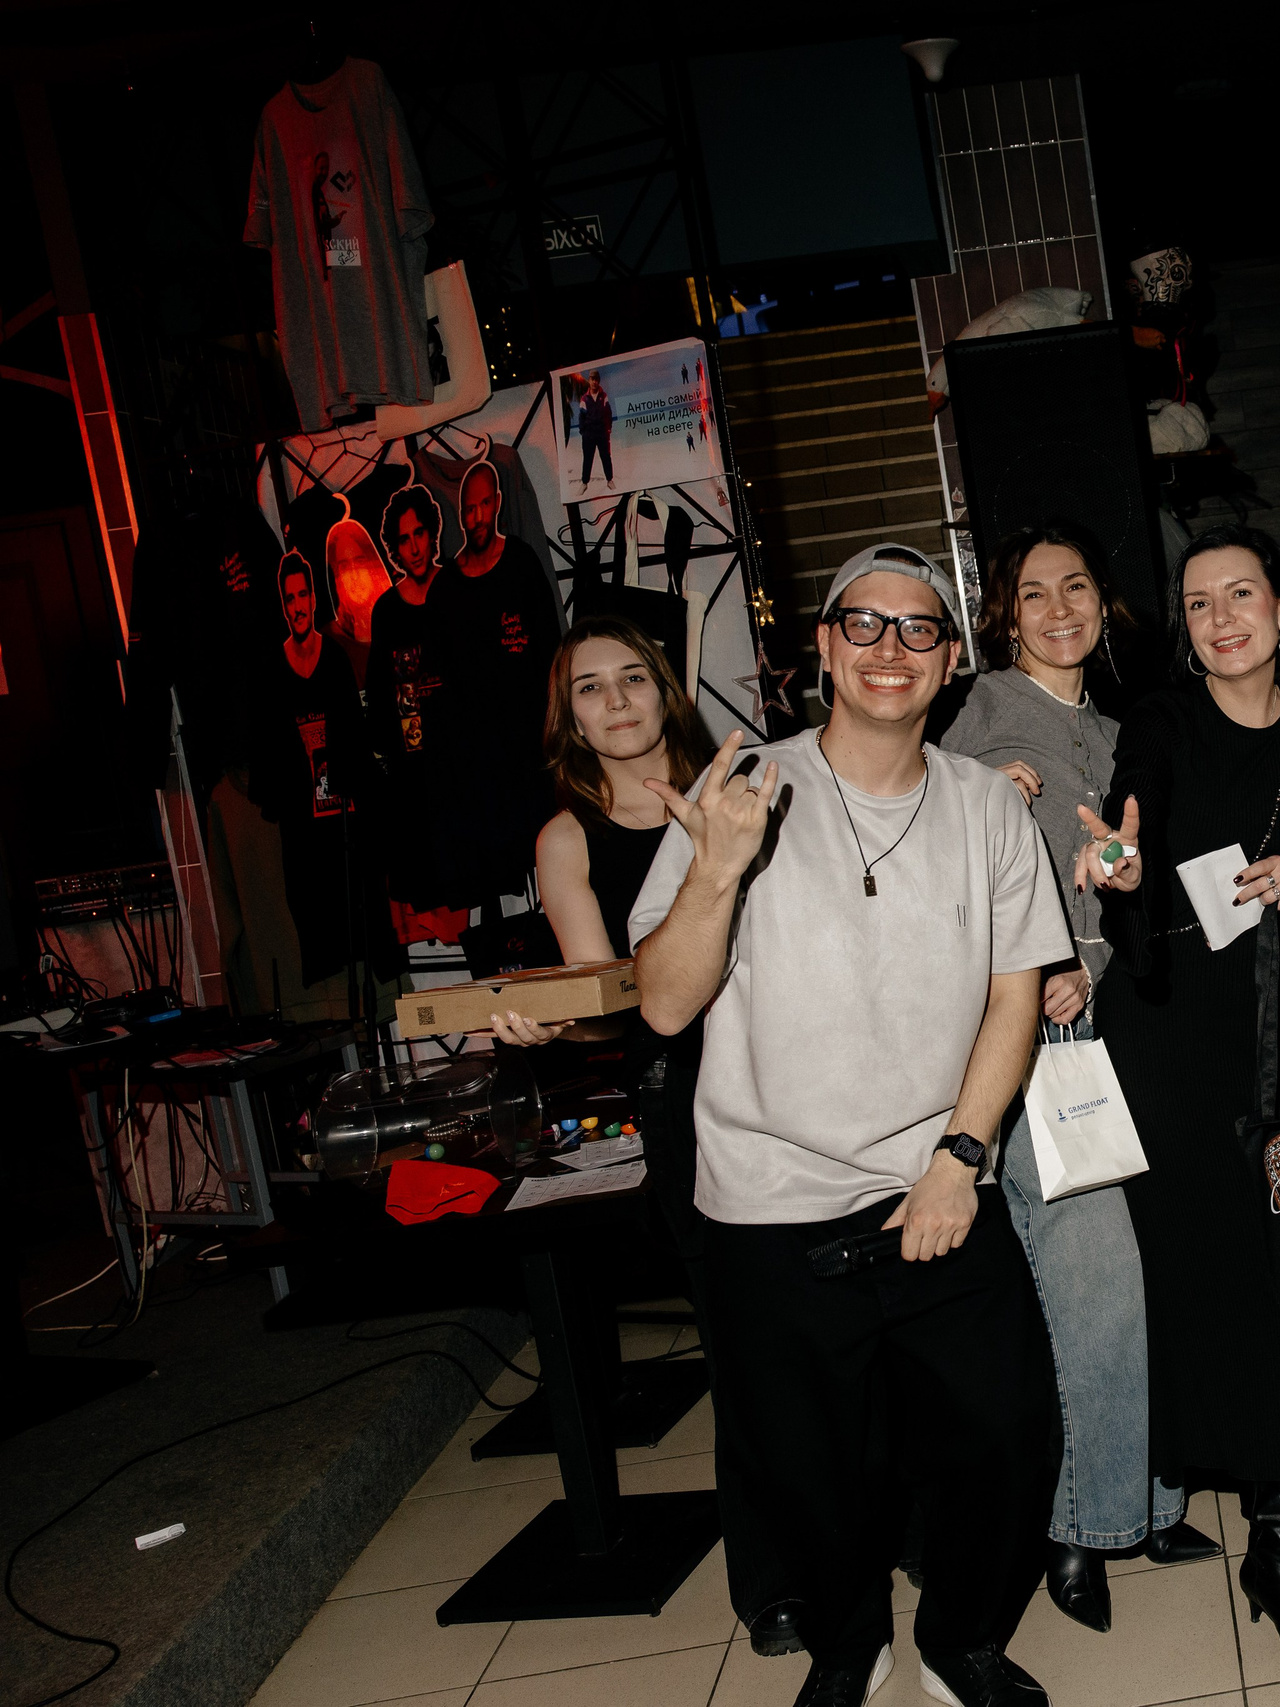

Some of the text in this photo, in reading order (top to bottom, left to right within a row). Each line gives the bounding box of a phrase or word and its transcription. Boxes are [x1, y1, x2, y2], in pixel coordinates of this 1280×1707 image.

[544, 224, 599, 251] ЫХОД
[627, 388, 703, 414] Антонь самый
[625, 411, 666, 429] лучший
[647, 420, 694, 437] на свете
[1068, 1097, 1109, 1114] GRAND FLOAT
